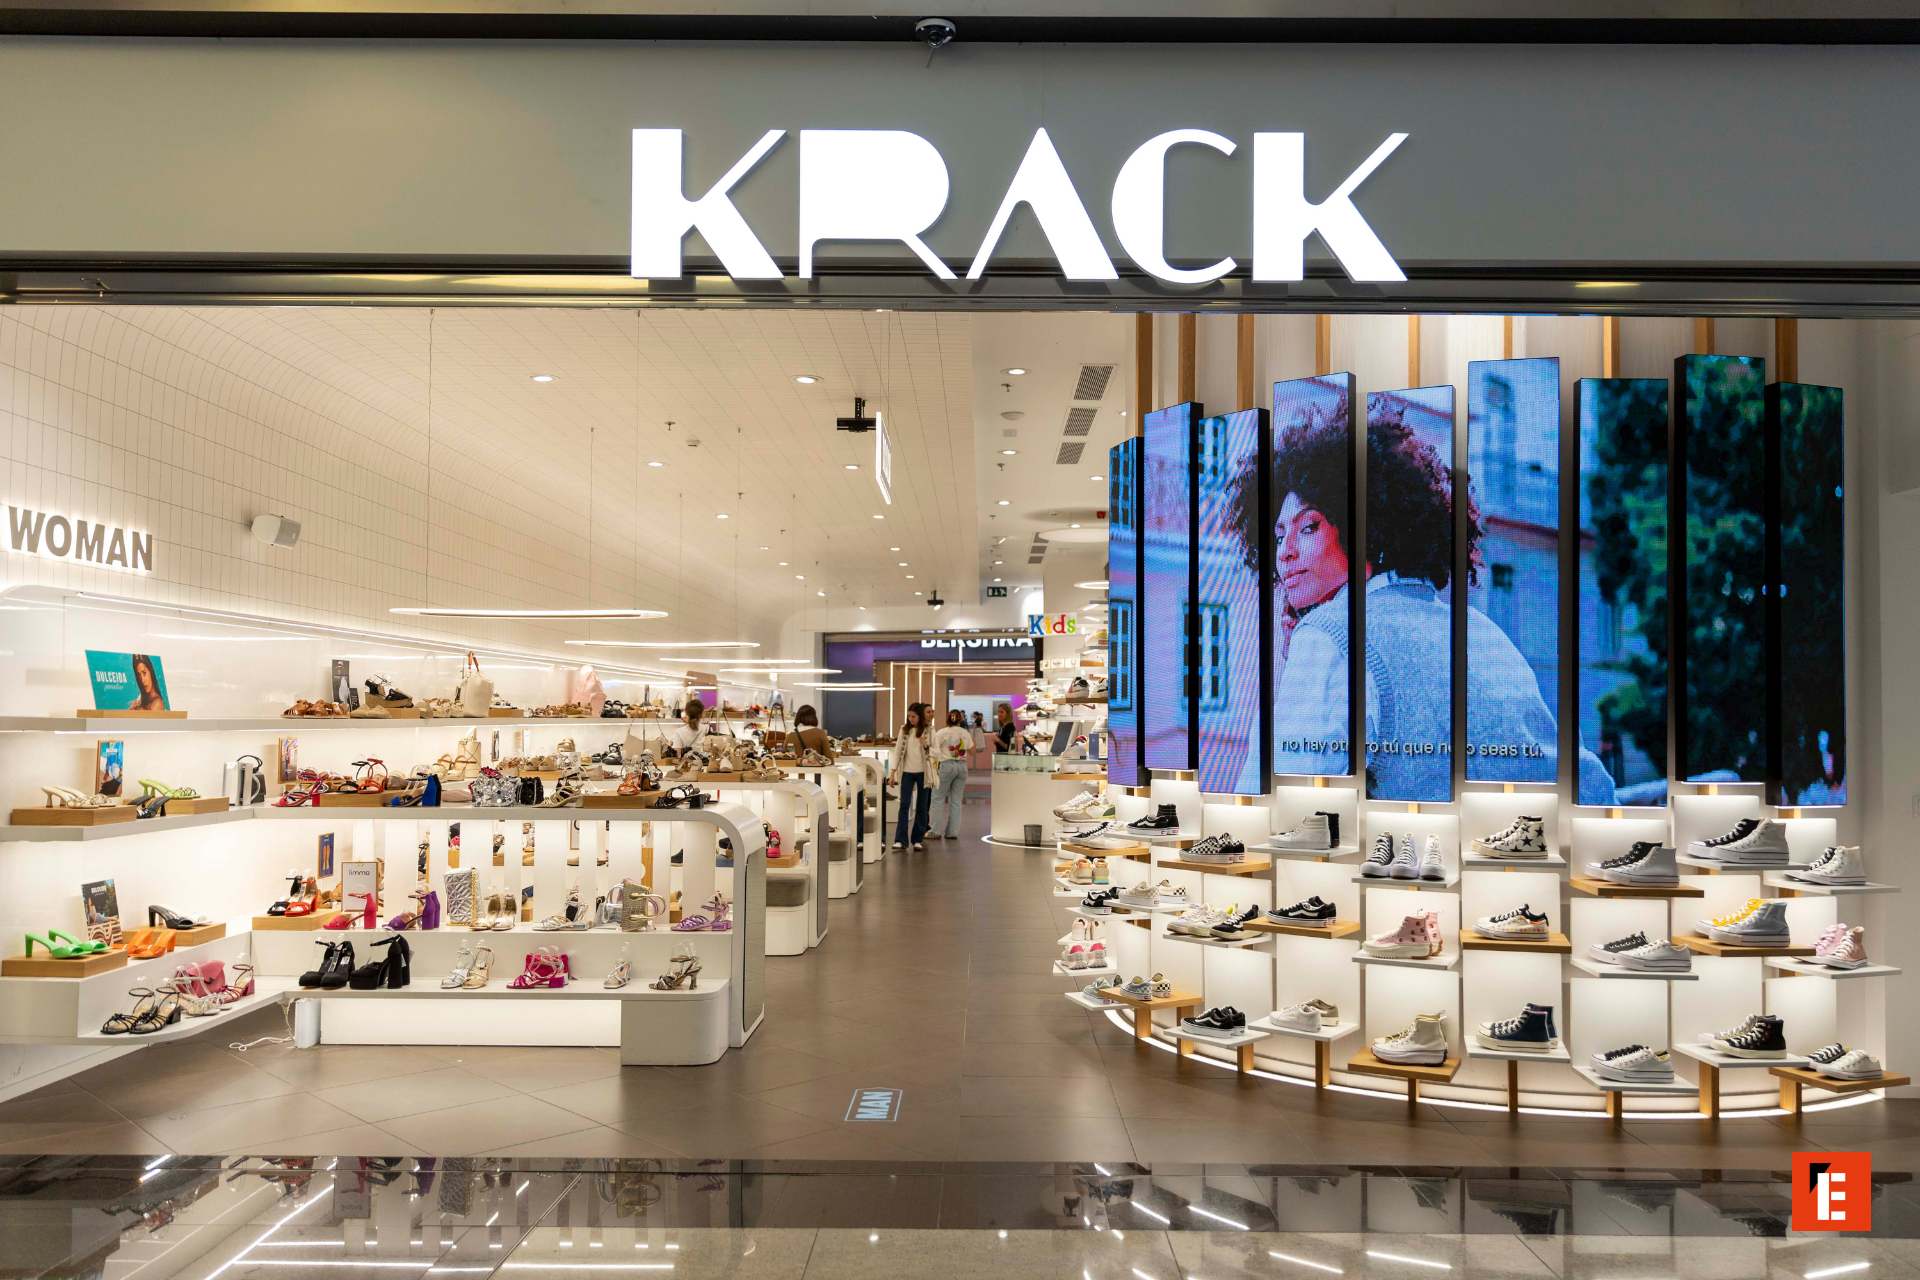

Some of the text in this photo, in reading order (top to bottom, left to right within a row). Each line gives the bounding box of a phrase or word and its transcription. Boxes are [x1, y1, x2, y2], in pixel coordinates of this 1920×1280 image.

[631, 127, 1410, 284] KRACK
[8, 505, 153, 571] WOMAN
[1029, 614, 1076, 636] Kids
[95, 670, 128, 684] DULCEIDA
[1282, 740, 1299, 752] no
[1303, 737, 1327, 755] hay
[1382, 738, 1399, 754] tú
[1403, 742, 1434, 757] que
[1480, 744, 1518, 757] seas
[1521, 742, 1543, 758] tú.
[855, 1091, 893, 1119] MAN
